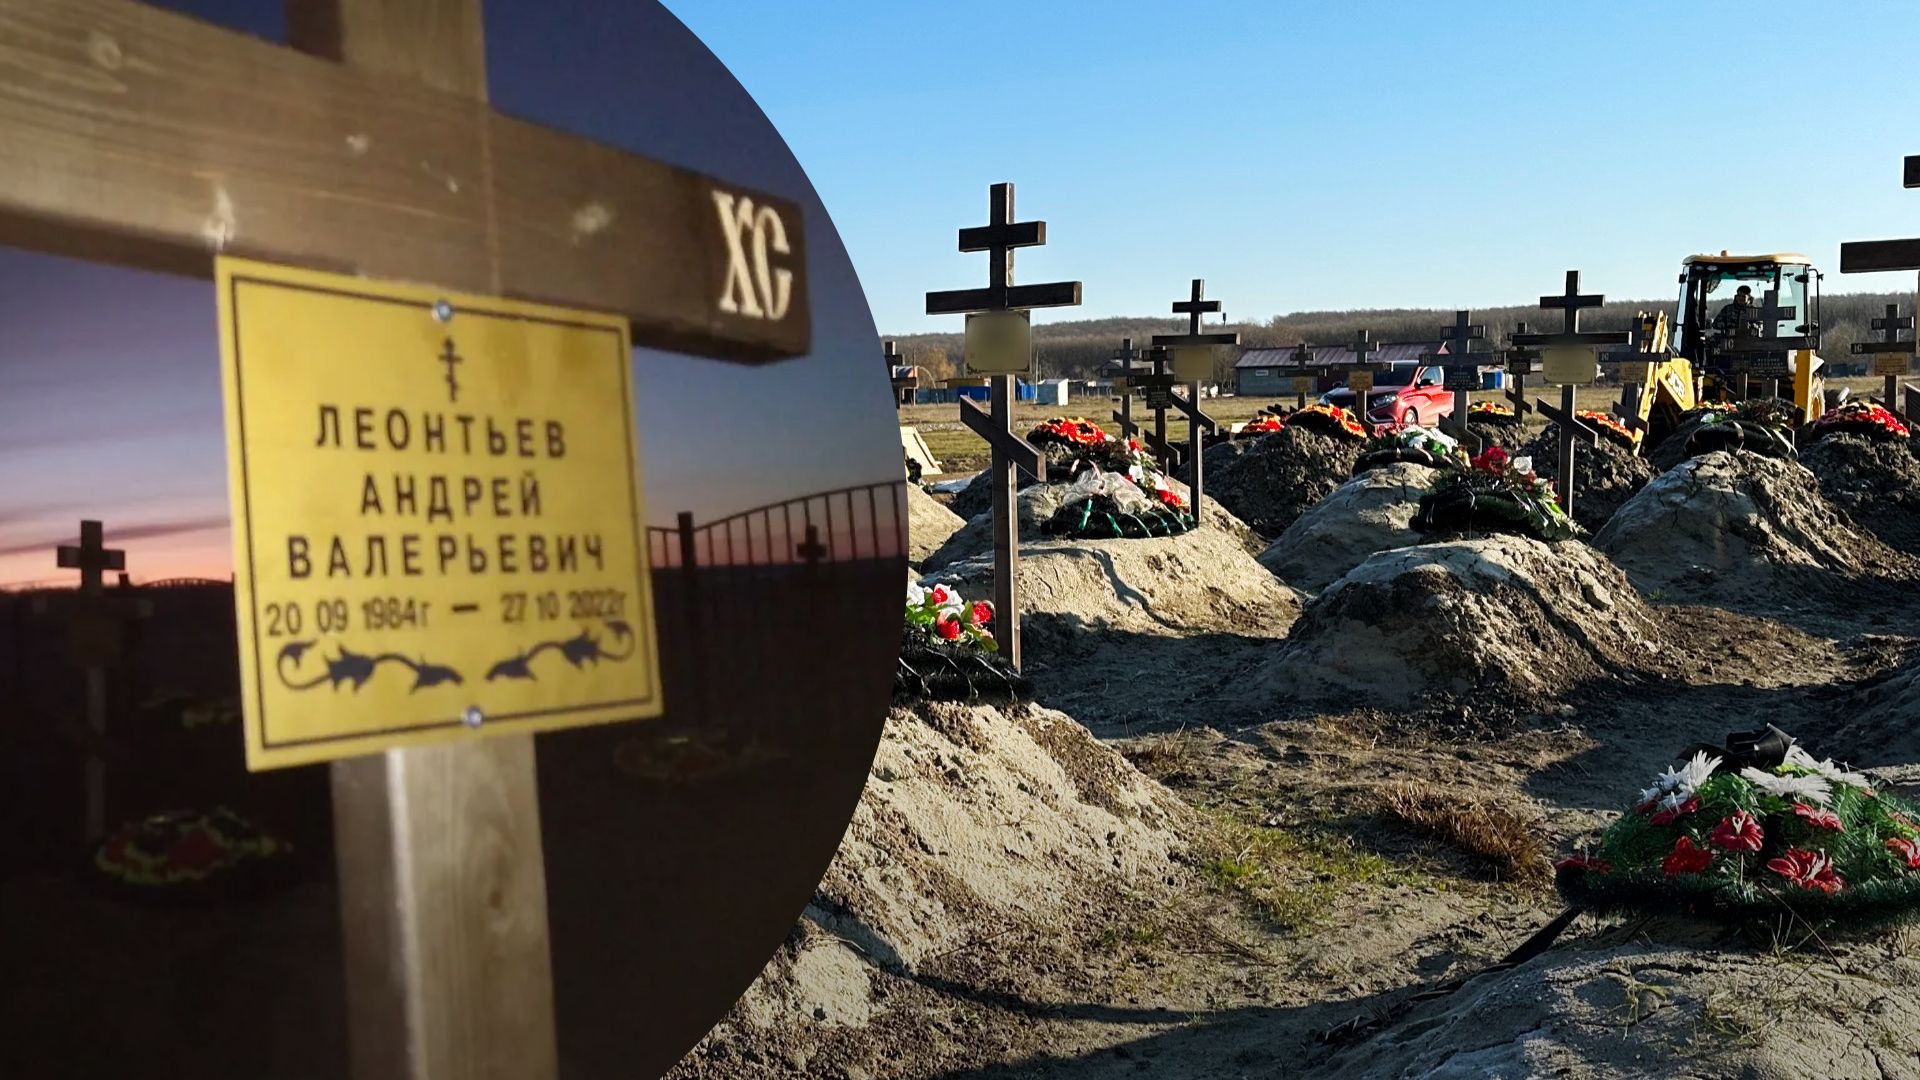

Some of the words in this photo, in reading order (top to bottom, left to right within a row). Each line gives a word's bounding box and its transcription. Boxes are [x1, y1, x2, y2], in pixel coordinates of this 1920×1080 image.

[1667, 370, 1685, 396] JCB
[314, 405, 566, 459] ЛЕОНТЬЕВ
[360, 471, 542, 522] АНДРЕЙ
[287, 535, 605, 579] ВАЛЕРЬЕВИЧ
[267, 603, 302, 636] 20
[317, 602, 349, 632] 09
[362, 598, 433, 629] 1984г
[502, 594, 527, 624] 27
[536, 591, 561, 621] 10
